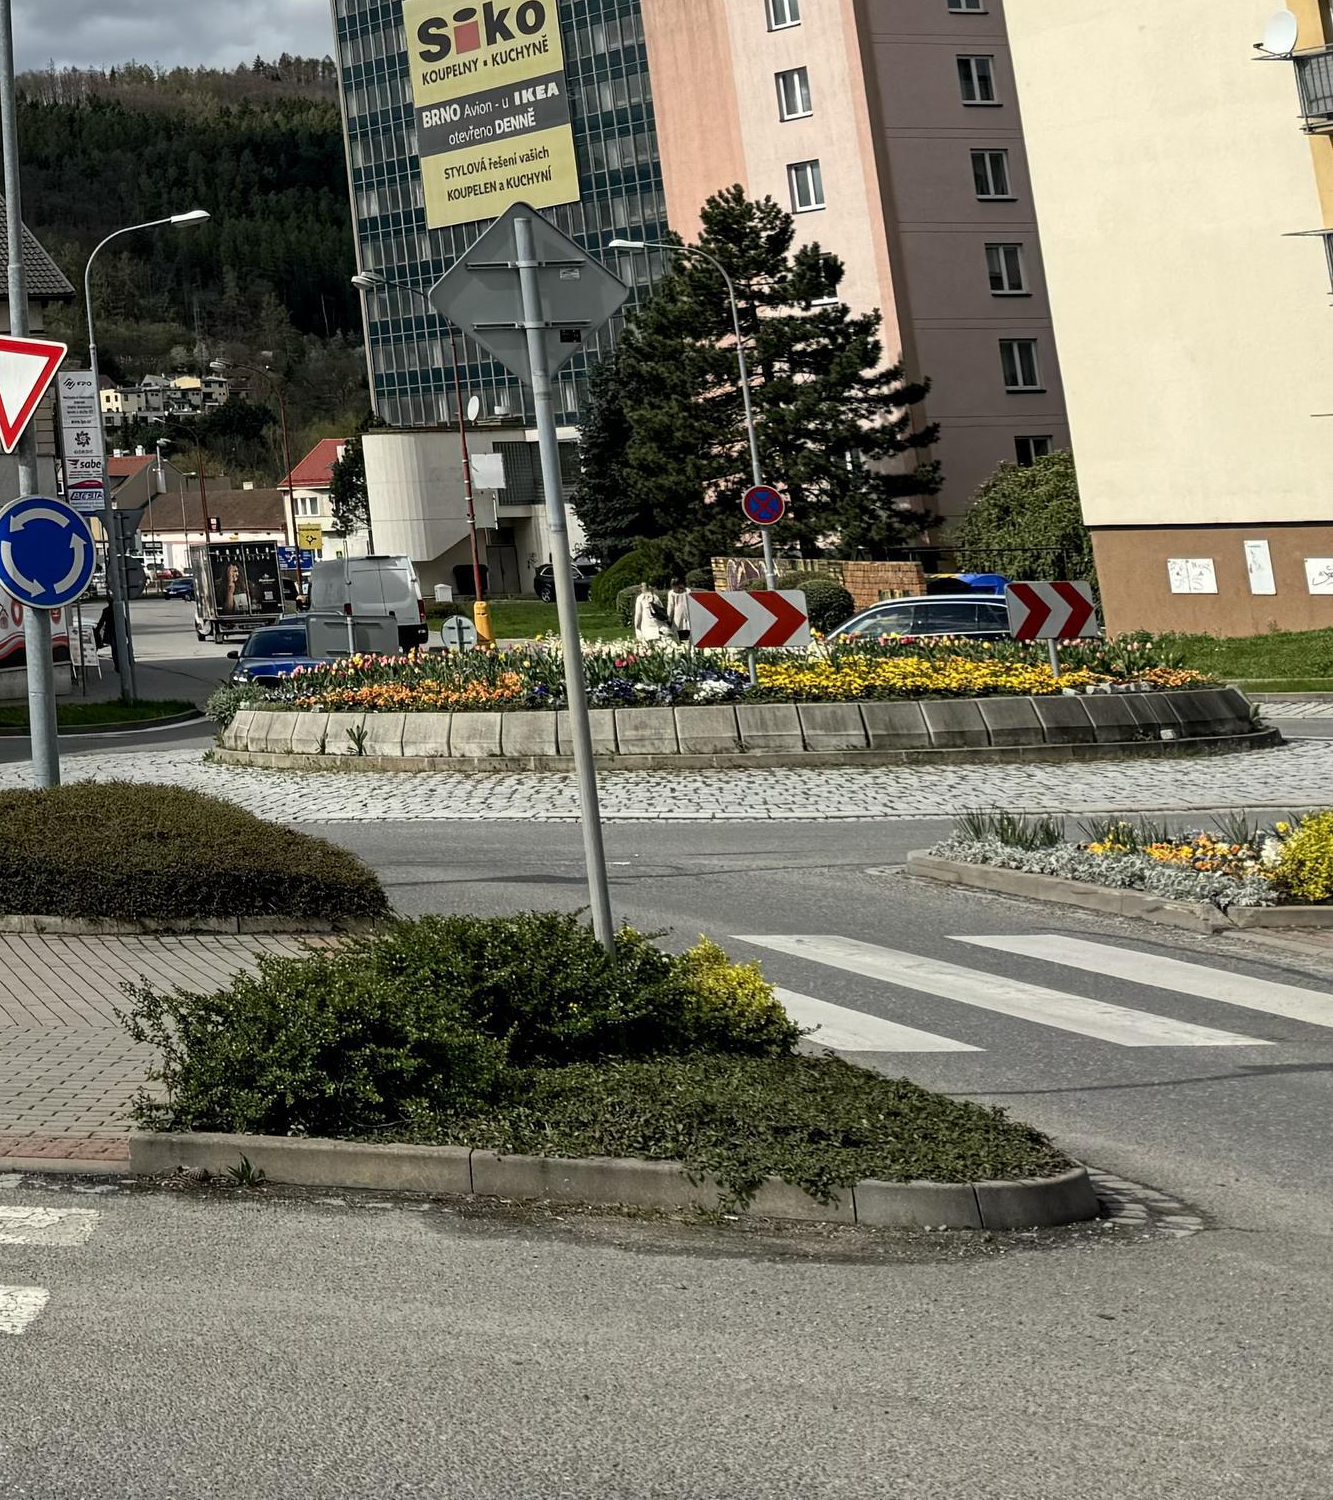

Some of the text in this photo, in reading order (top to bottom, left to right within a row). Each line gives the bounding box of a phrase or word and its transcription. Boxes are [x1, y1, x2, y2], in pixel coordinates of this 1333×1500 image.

[422, 34, 549, 85] KOUPELNY KUCHYNĚ
[422, 82, 559, 128] BRNO Avion u IKEA
[449, 107, 536, 145] otevřeno DENNĚ
[444, 146, 549, 179] STYLOVÁ řešení vašich
[447, 165, 552, 201] KOUPELEN a KUCHYNÍ
[80, 459, 101, 468] sabe
